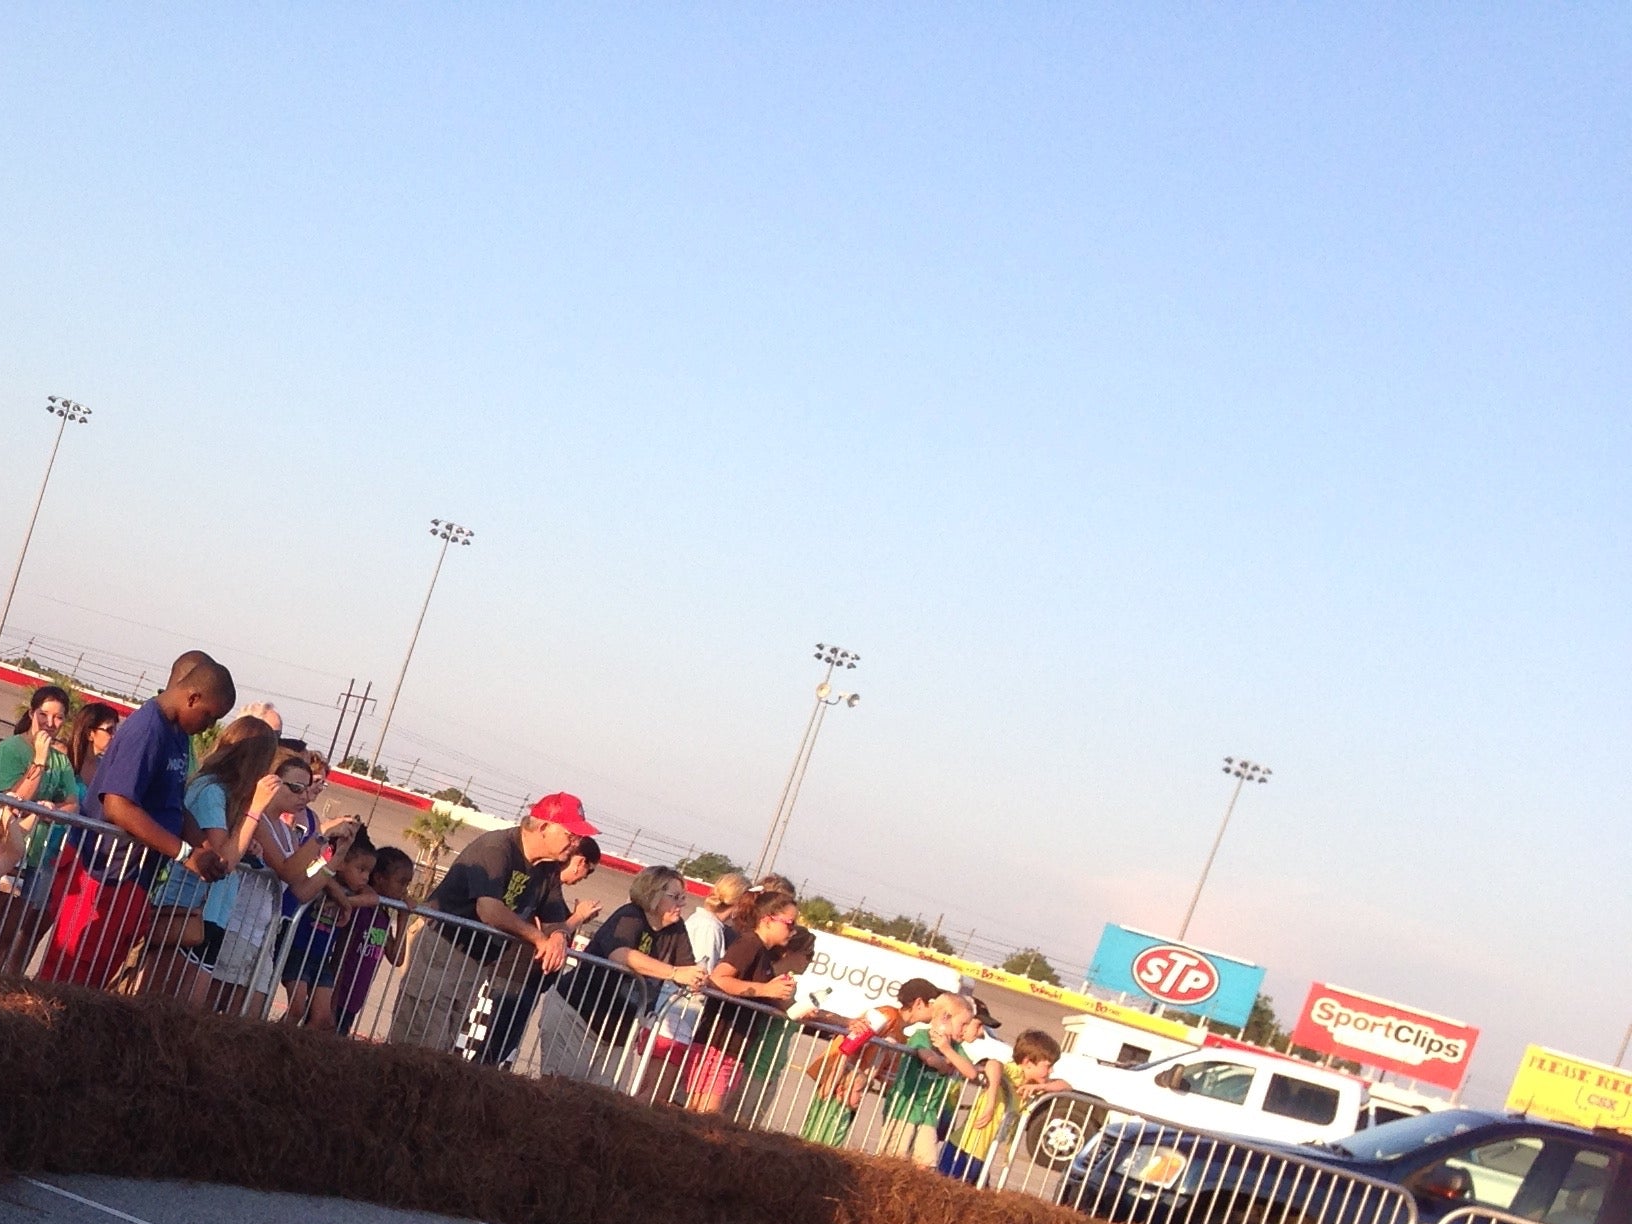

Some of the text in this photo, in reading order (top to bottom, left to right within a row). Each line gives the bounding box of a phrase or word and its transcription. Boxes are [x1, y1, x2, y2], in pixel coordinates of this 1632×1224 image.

[811, 951, 903, 1001] Budge
[1139, 951, 1210, 994] STP
[1529, 1055, 1591, 1084] PLEASE
